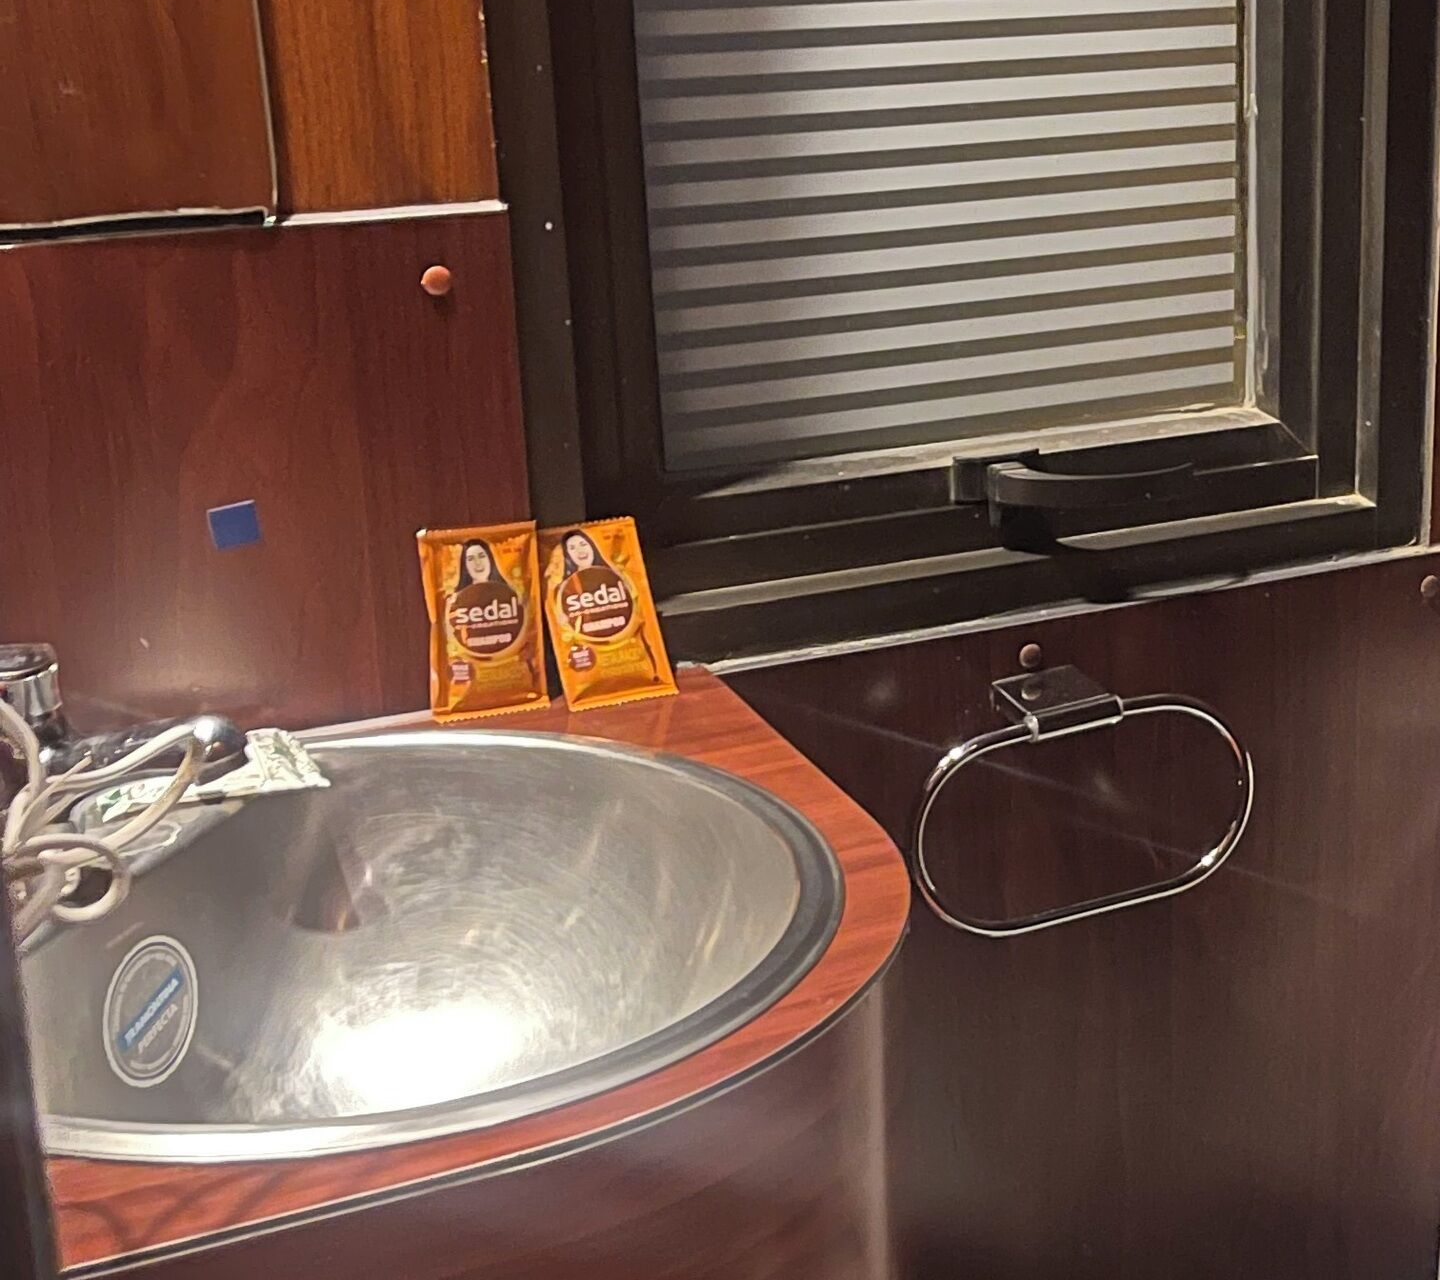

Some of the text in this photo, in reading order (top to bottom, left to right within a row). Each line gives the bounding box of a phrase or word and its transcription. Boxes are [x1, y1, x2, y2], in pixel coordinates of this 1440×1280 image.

[455, 596, 518, 624] sedal
[566, 581, 626, 612] sedal
[125, 978, 179, 1045] TRAMONTINA
